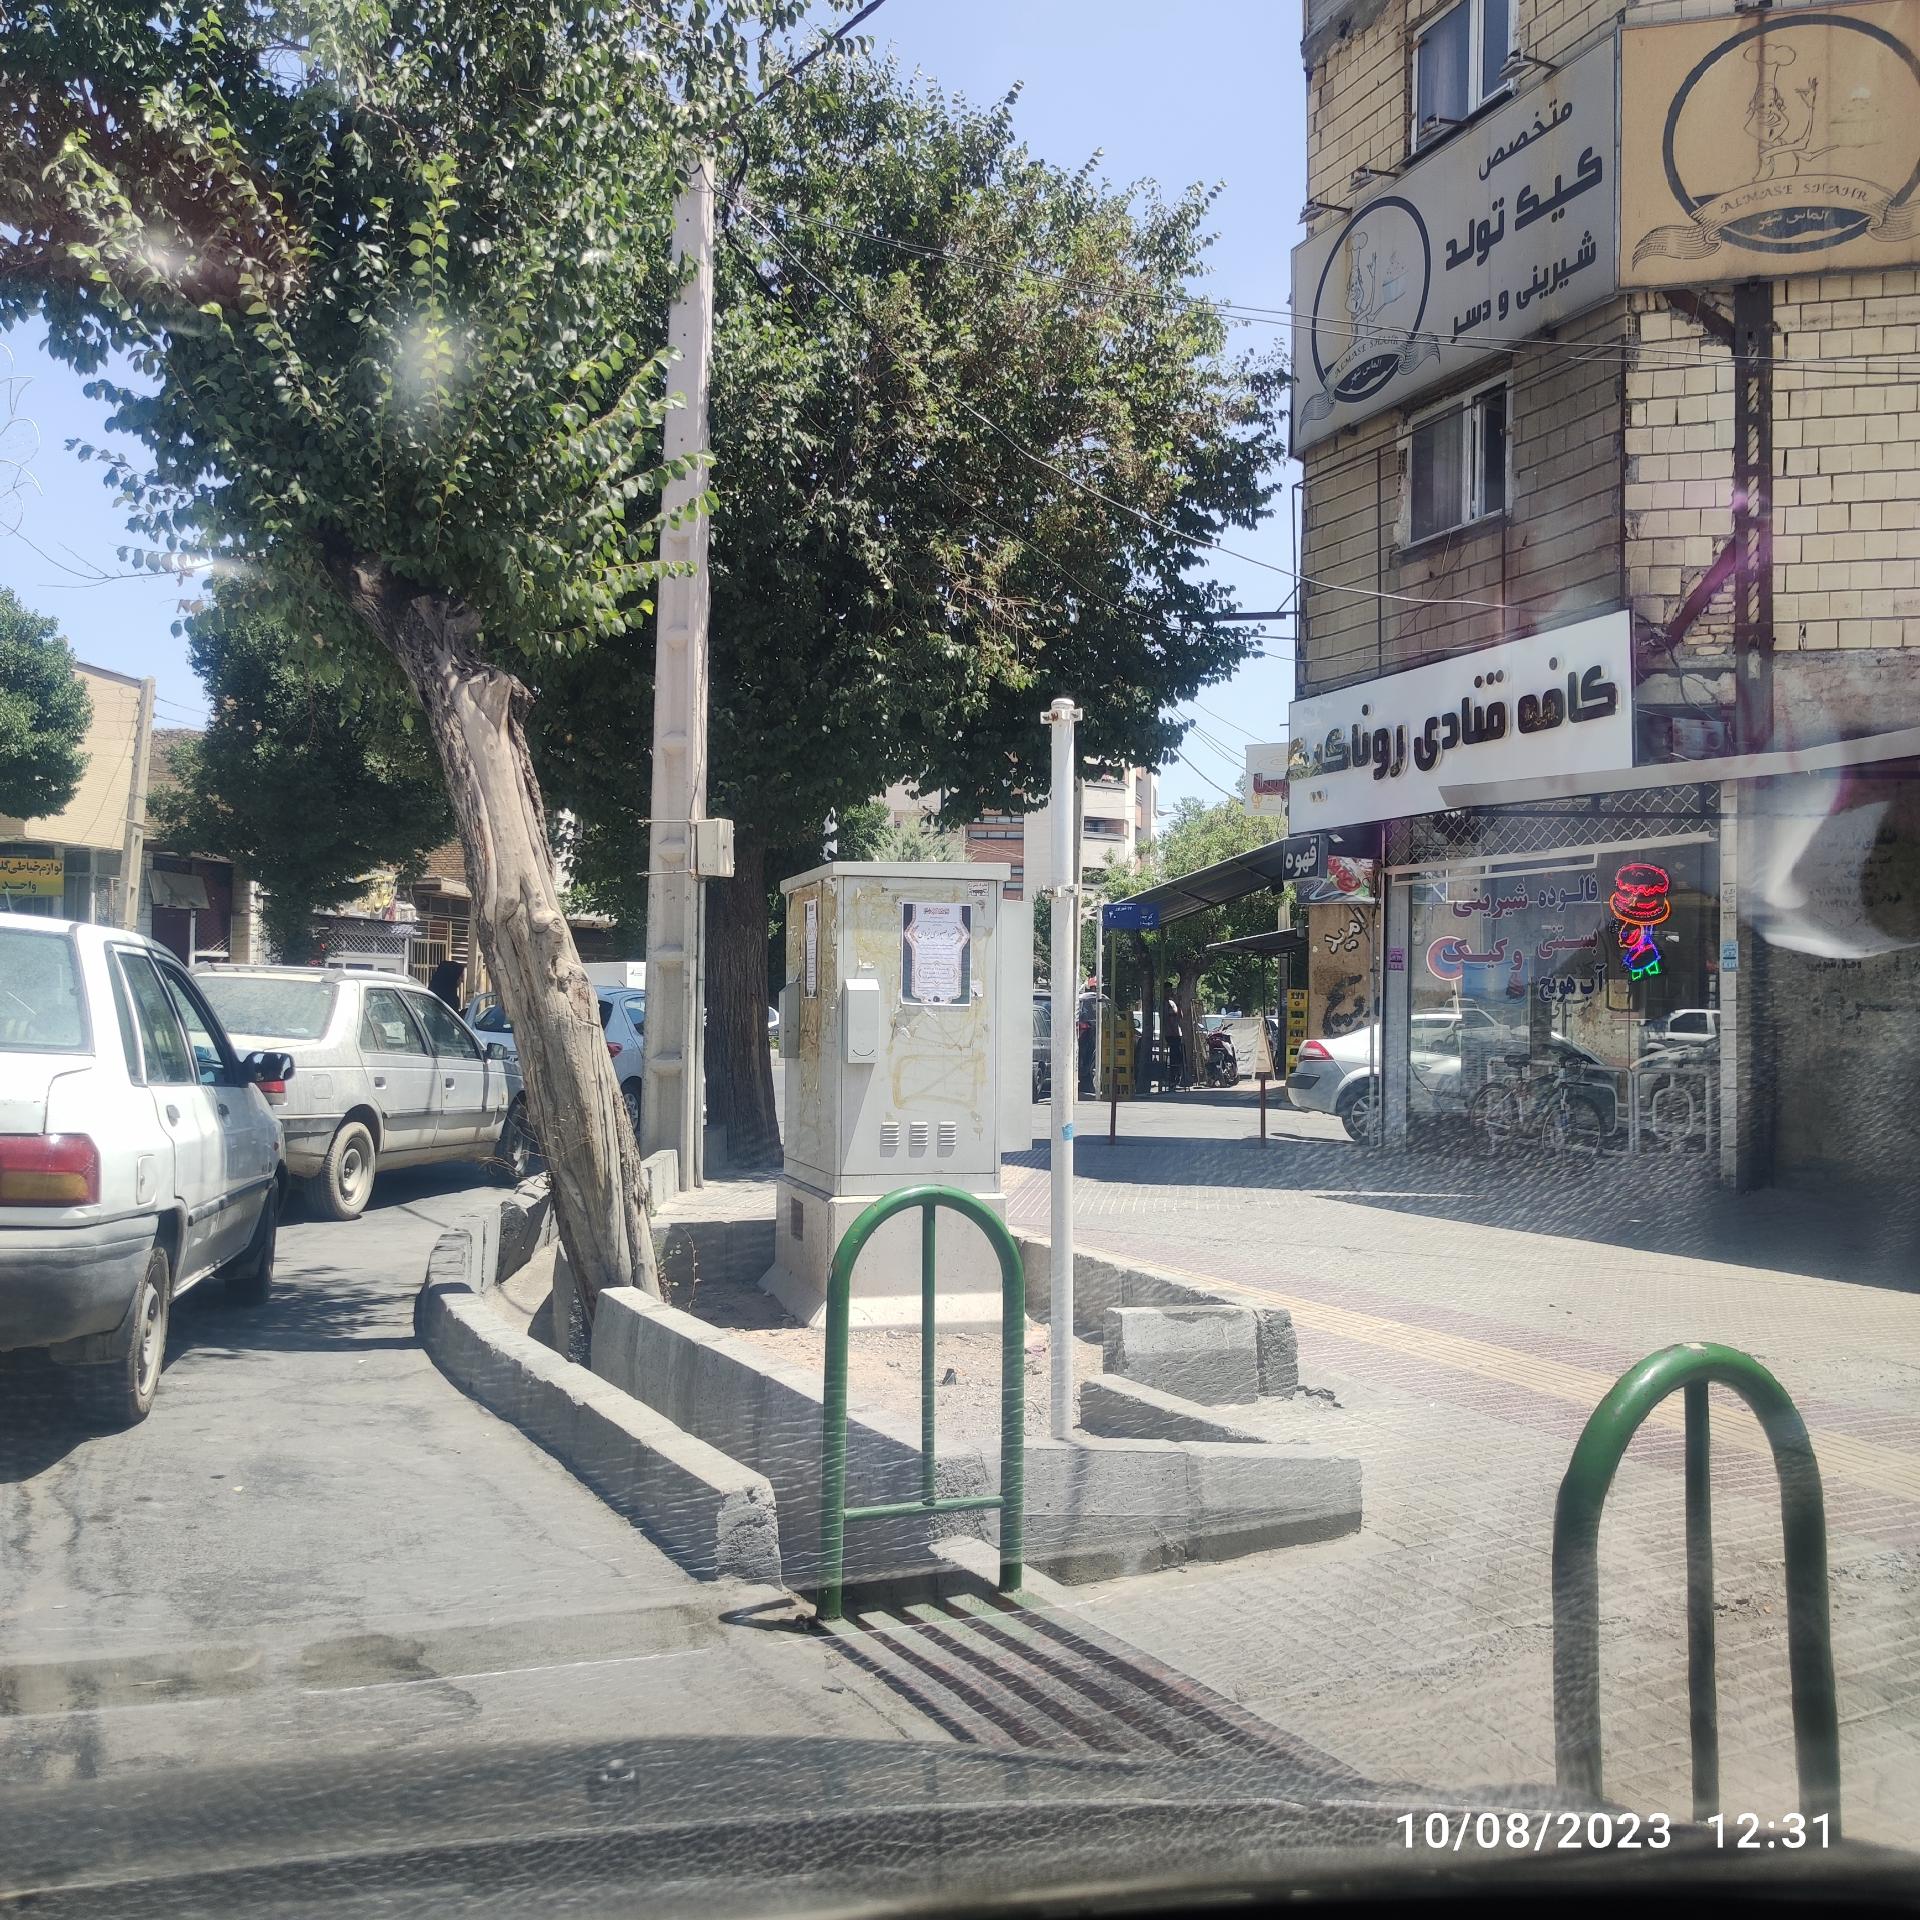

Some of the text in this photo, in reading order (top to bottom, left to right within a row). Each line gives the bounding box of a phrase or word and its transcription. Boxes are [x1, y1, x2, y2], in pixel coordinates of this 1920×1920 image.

[1478, 99, 1573, 181] متخصص
[1445, 147, 1603, 271] کیک تولد
[1450, 230, 1596, 344] شیرینی و دسر
[1518, 656, 1619, 735] کافه
[1413, 669, 1507, 772] قنادی
[8, 861, 40, 874] خیاطی
[39, 862, 63, 876] لوازم
[1285, 837, 1317, 877] قهوه
[1452, 872, 1599, 919] فالوده شیرینی
[1324, 907, 1369, 954] امید
[1538, 925, 1599, 959] بستنی
[1441, 938, 1508, 969] کیک
[1511, 949, 1523, 971] و
[1539, 963, 1607, 1003] آب هویج
